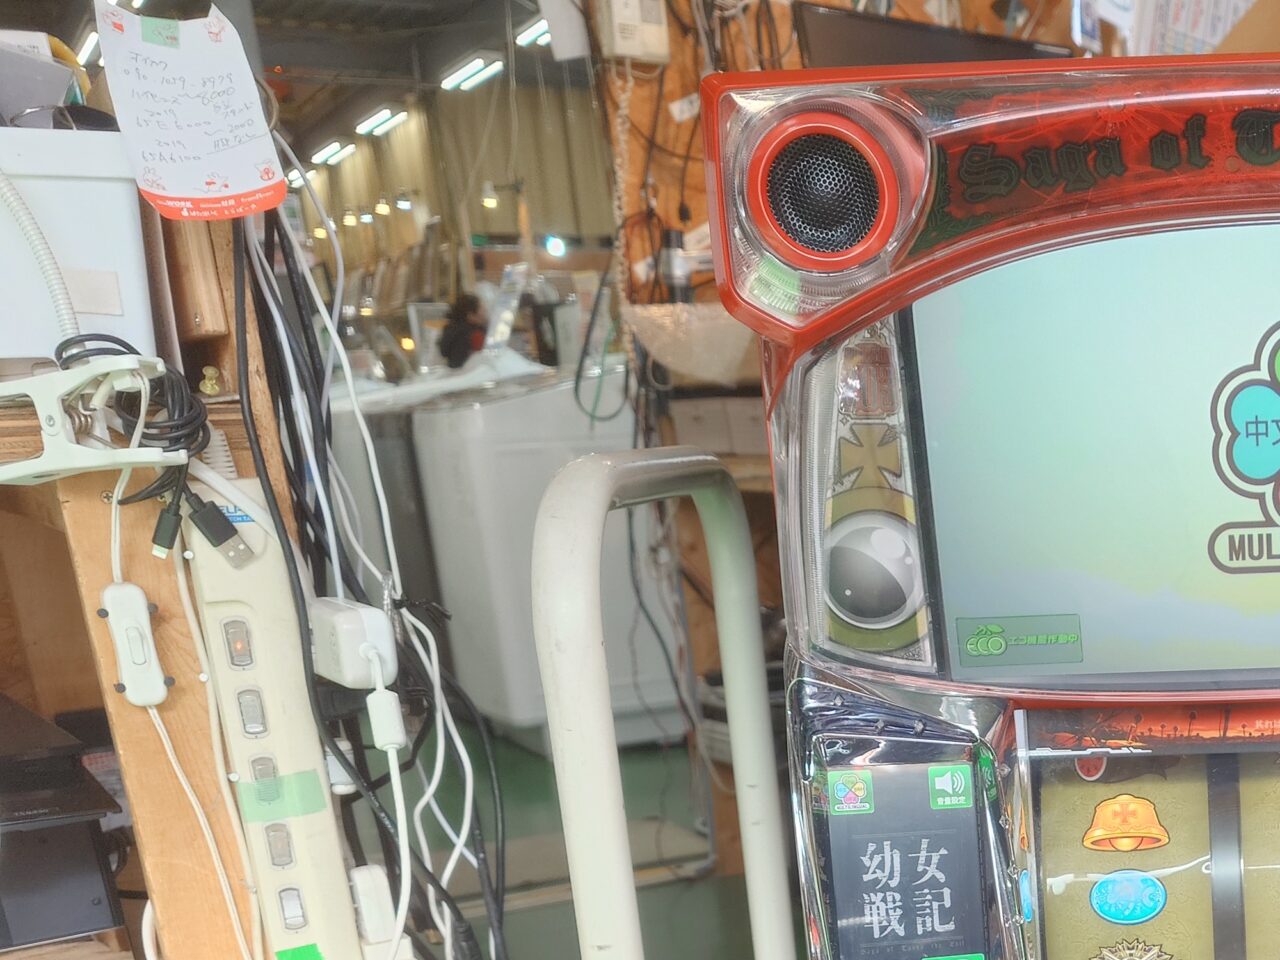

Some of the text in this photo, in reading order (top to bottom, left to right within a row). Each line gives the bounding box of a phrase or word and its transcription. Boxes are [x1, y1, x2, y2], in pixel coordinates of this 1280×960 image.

[959, 136, 1129, 201] Saga
[1149, 112, 1212, 171] of
[860, 839, 948, 889] 幼女
[862, 887, 955, 938] 戦記
